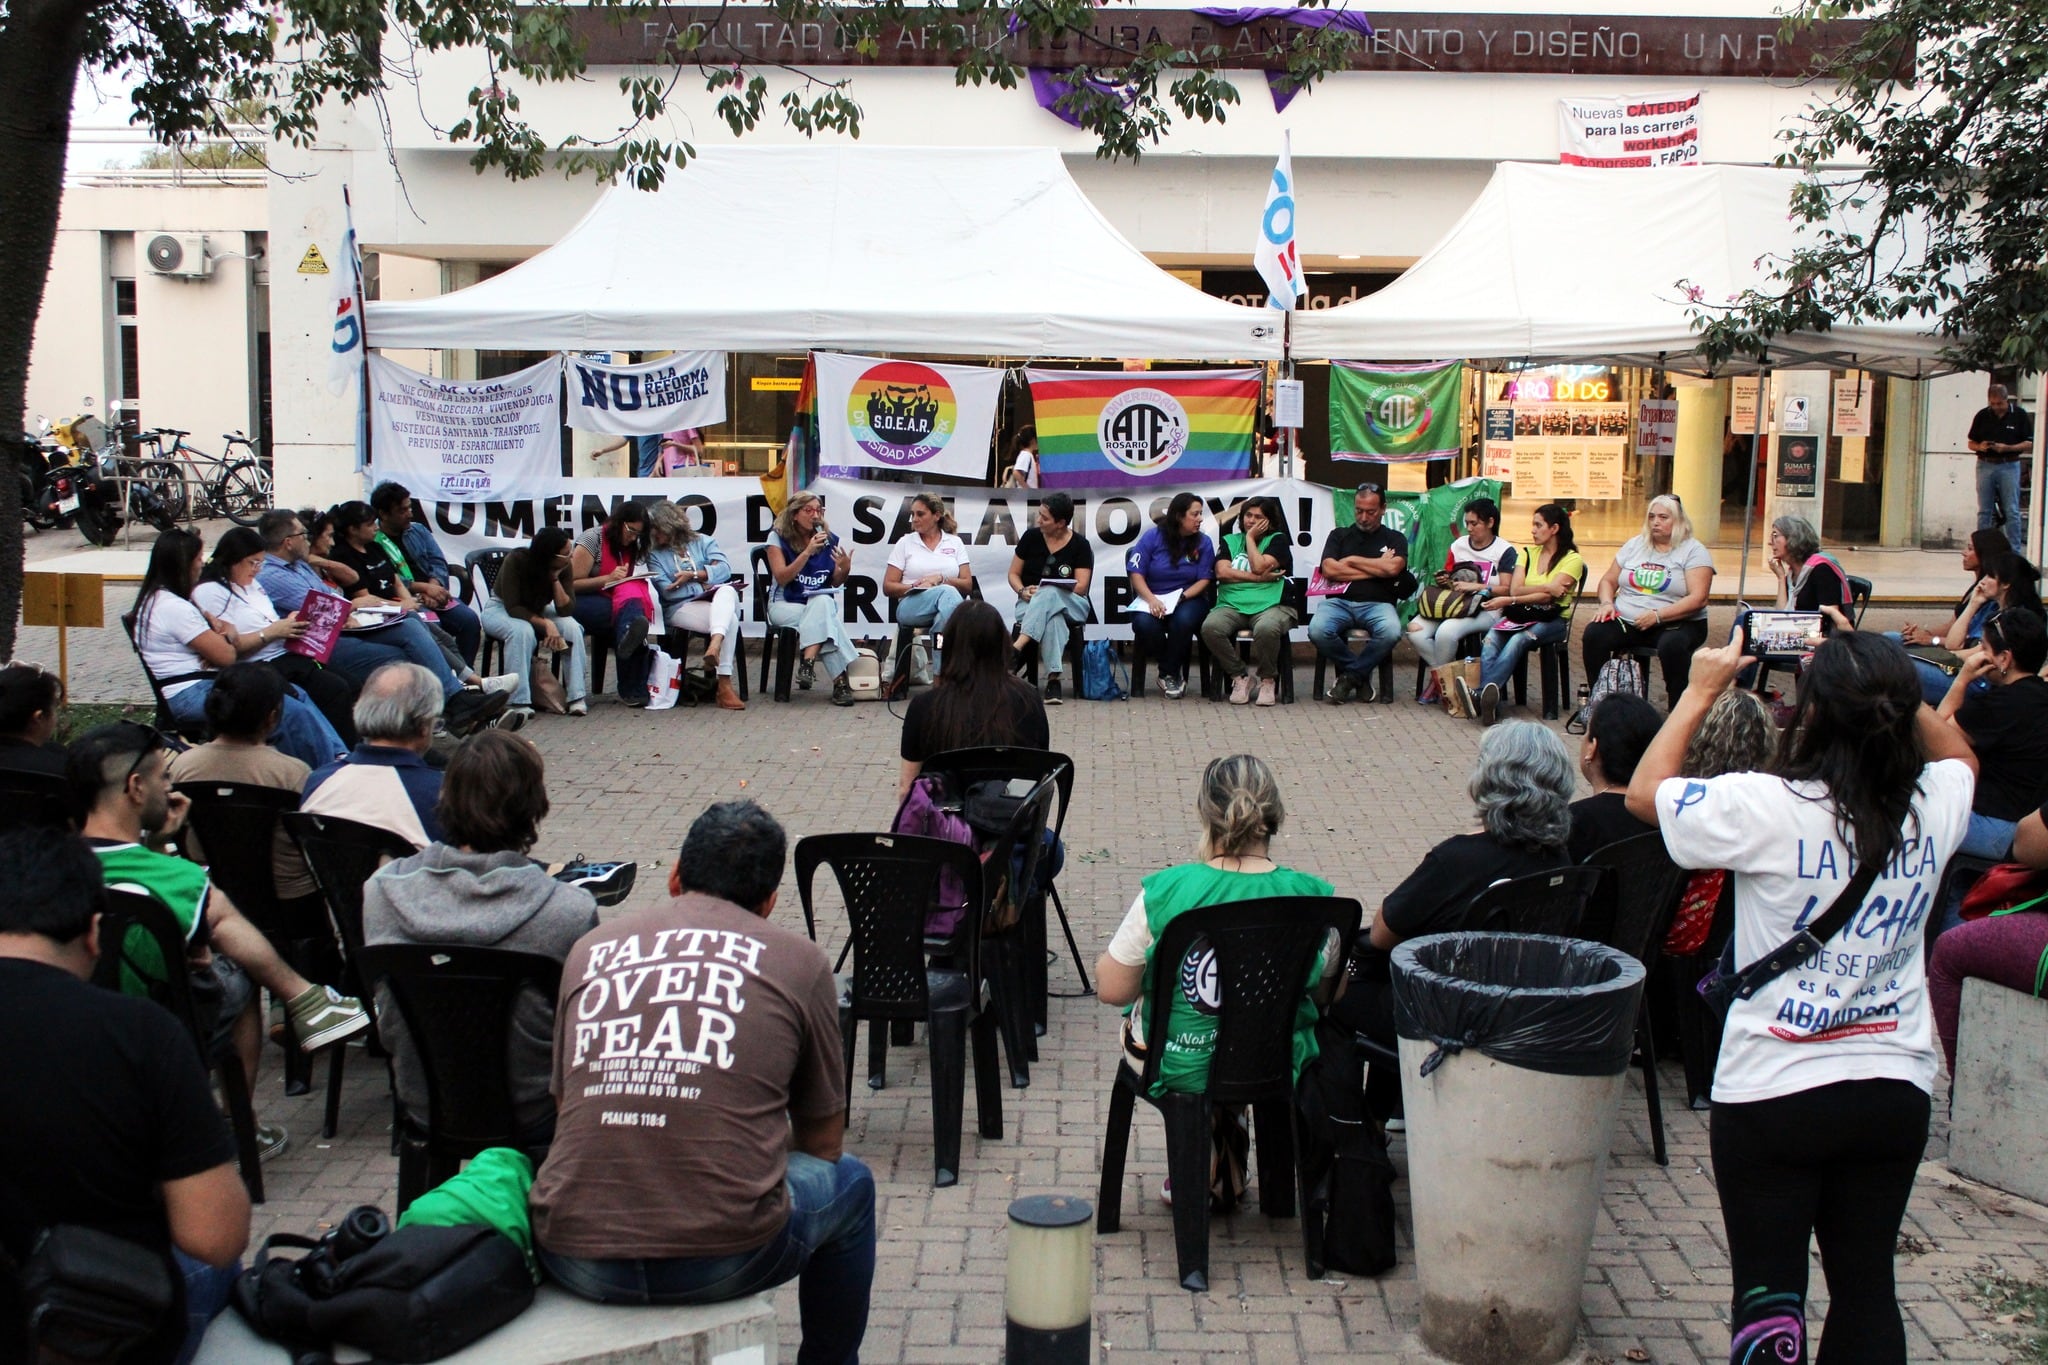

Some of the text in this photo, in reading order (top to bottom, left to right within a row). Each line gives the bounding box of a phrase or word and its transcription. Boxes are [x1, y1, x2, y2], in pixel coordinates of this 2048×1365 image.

[643, 22, 823, 49] FACULTAD
[1478, 29, 1498, 56] Y
[1512, 26, 1641, 58] DISEÑO
[1573, 106, 1624, 120] Nuevas
[1585, 126, 1617, 139] para
[1620, 123, 1640, 135] las
[1660, 145, 1698, 165] FAPyD
[575, 364, 677, 412] NO A LA
[644, 367, 710, 396] REFORMA
[1510, 381, 1609, 400] ARQ DI DG
[417, 387, 455, 402] CUMPLA
[646, 382, 709, 409] LABORAL
[1105, 391, 1178, 416] DIVERSIDAD
[437, 403, 484, 414] ADECUADA
[489, 398, 529, 414] VIVIENDA
[1380, 395, 1416, 429] ATE
[415, 411, 521, 426] VESTIMENTA EDUCACIÓN
[874, 414, 930, 433] S.O.E.A.R.
[391, 421, 541, 438] ASISTENCIA SANITARIA TRANSPORTE
[408, 436, 525, 450] PREVISIÓN ESPARCIMIENTO
[1105, 441, 1149, 449] ROSARIO
[441, 453, 495, 465] VACACIONES
[1798, 838, 1838, 880] LA
[1792, 882, 1930, 950] LCHA
[582, 928, 767, 981] FAITH
[1795, 944, 1915, 978] UE SE PIERDE
[577, 961, 745, 1021] OVER
[1798, 980, 1815, 993] es
[1826, 983, 1841, 998] la
[1884, 979, 1900, 992] se
[572, 1006, 736, 1070] FEAR
[589, 1061, 602, 1073] THE
[603, 1058, 628, 1071] LORD
[629, 1058, 639, 1070] IS
[641, 1059, 656, 1071] ON
[657, 1060, 673, 1072] MY
[603, 1070, 677, 1085] I WILL NOT FEAR
[584, 1082, 702, 1100] WHAT CAN MAN DO TO ME?
[600, 1111, 667, 1127] PSALMS 118:6
